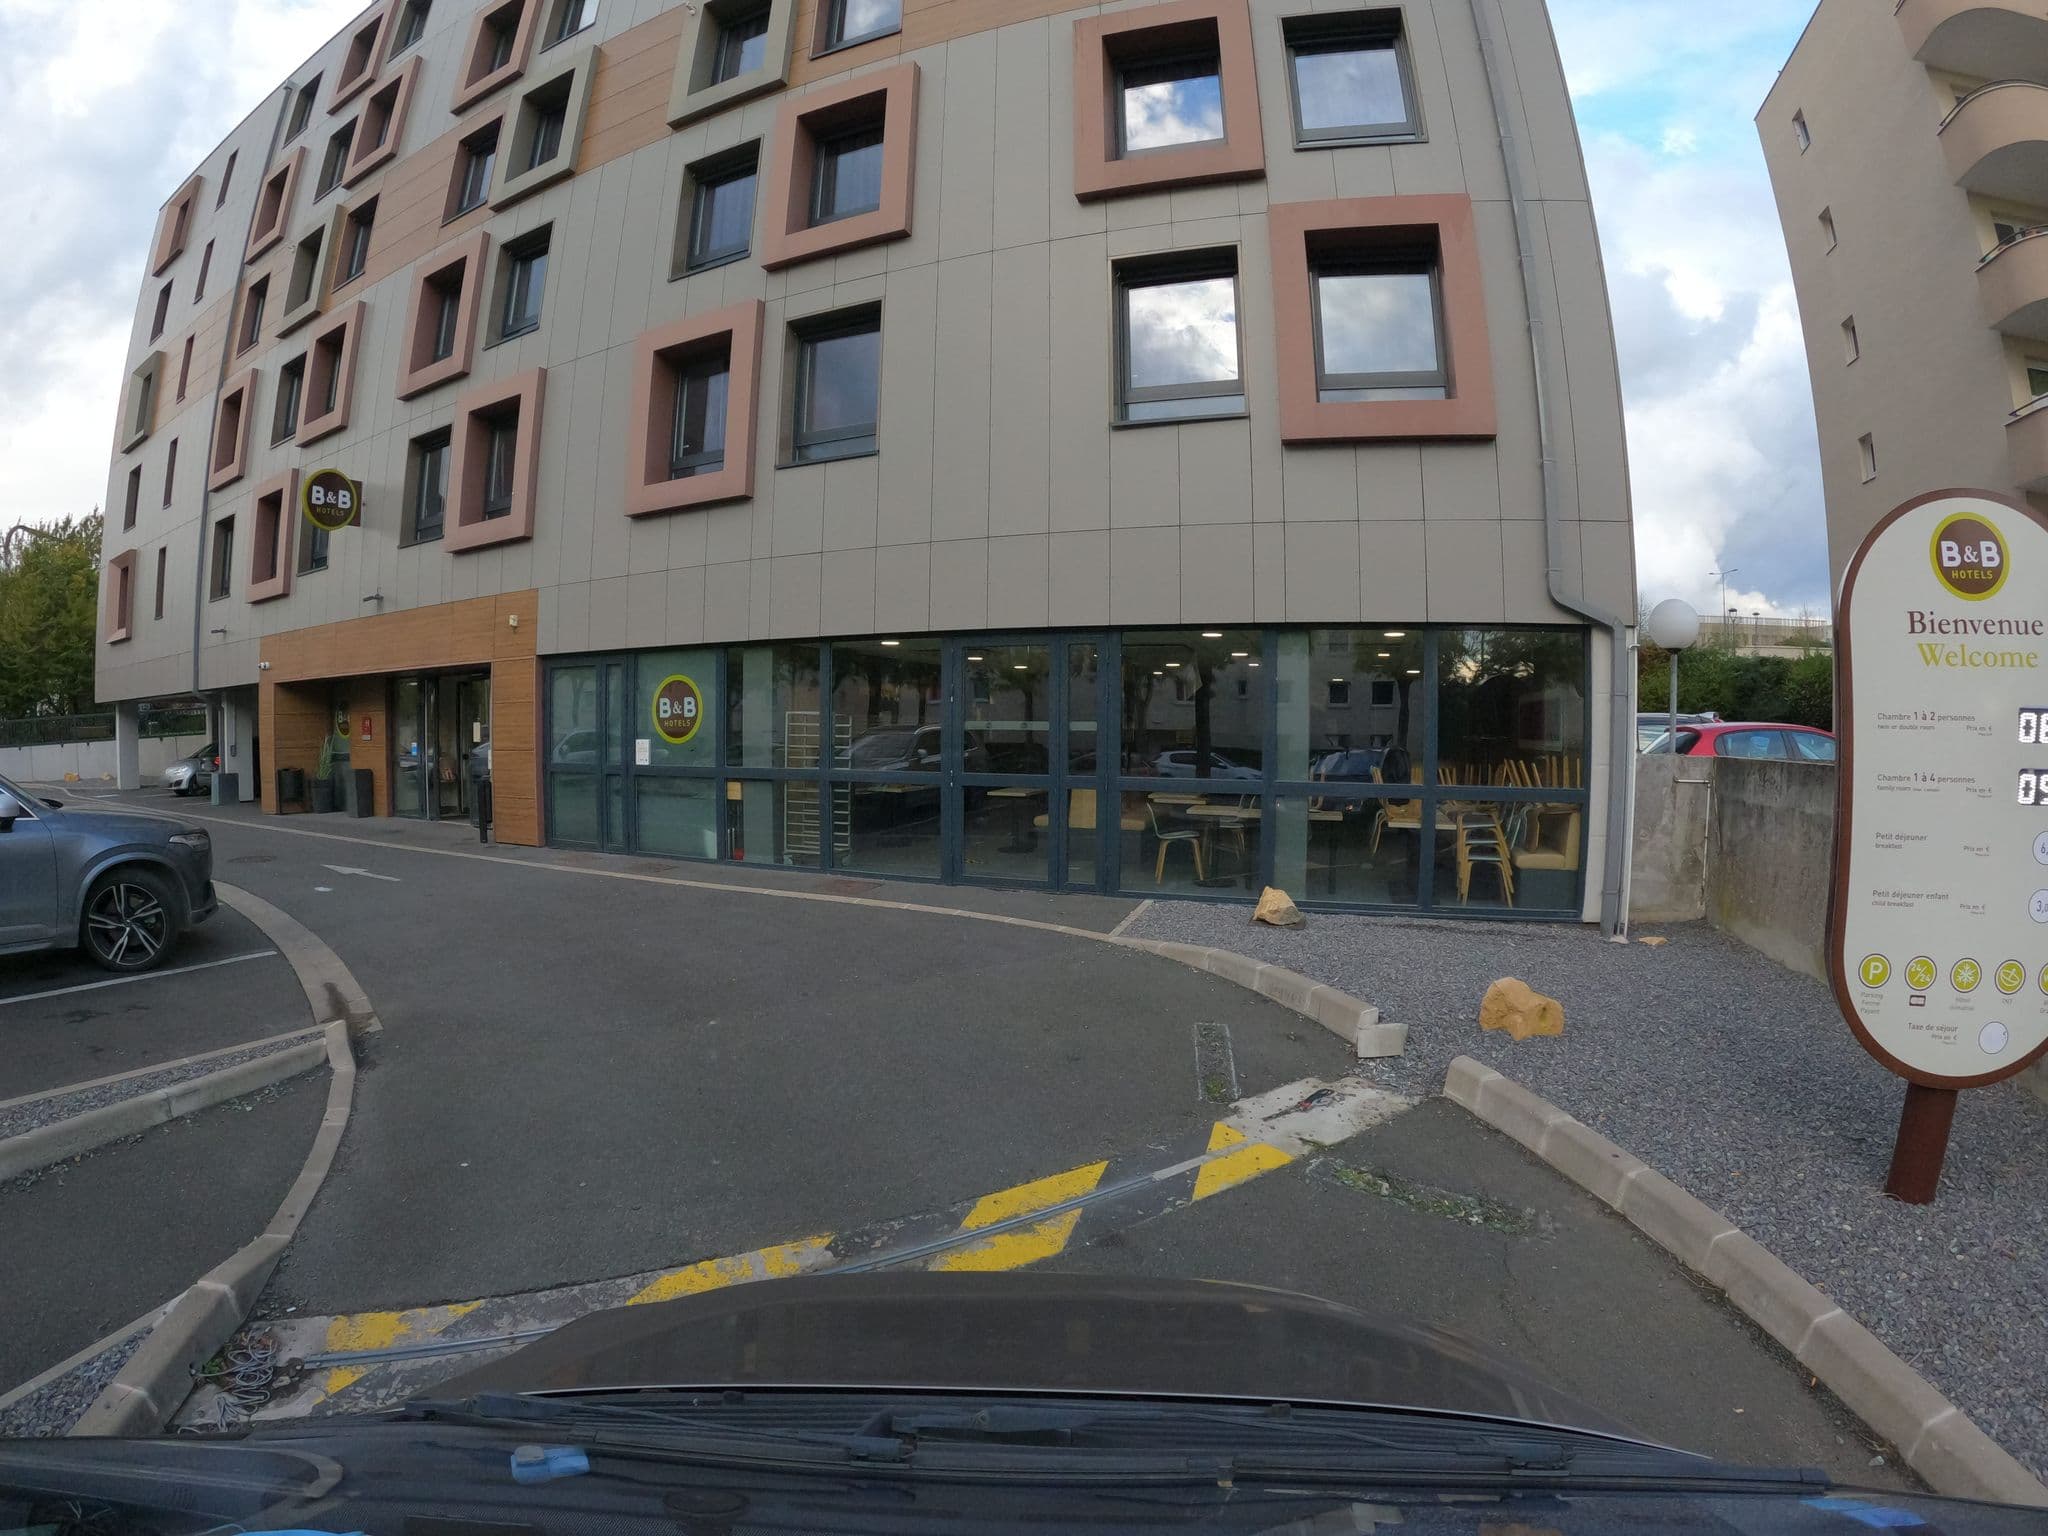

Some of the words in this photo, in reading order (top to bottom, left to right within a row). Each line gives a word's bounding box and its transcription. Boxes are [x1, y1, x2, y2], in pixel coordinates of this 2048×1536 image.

[311, 485, 351, 509] B&B
[316, 507, 344, 516] HOTELS
[1941, 540, 2001, 567] B&B
[1951, 570, 1993, 579] HOTELS
[1907, 611, 2043, 635] Bienvenue
[1918, 642, 2038, 668] Welcome
[659, 697, 696, 718] B&B
[1878, 712, 1911, 720] Chambre
[1914, 712, 1918, 720] 1
[1922, 710, 1927, 721] à
[1930, 712, 1935, 721] 2
[1878, 774, 1911, 782] Chambre
[1914, 773, 1918, 782] 1
[1922, 772, 1927, 782] à
[1930, 773, 1935, 782] 4
[1937, 776, 1975, 784] personnes
[1876, 832, 1893, 840] Petit
[1873, 889, 1890, 897] Petit
[1926, 892, 1949, 900] enfant
[1908, 1022, 1923, 1030] Taxe
